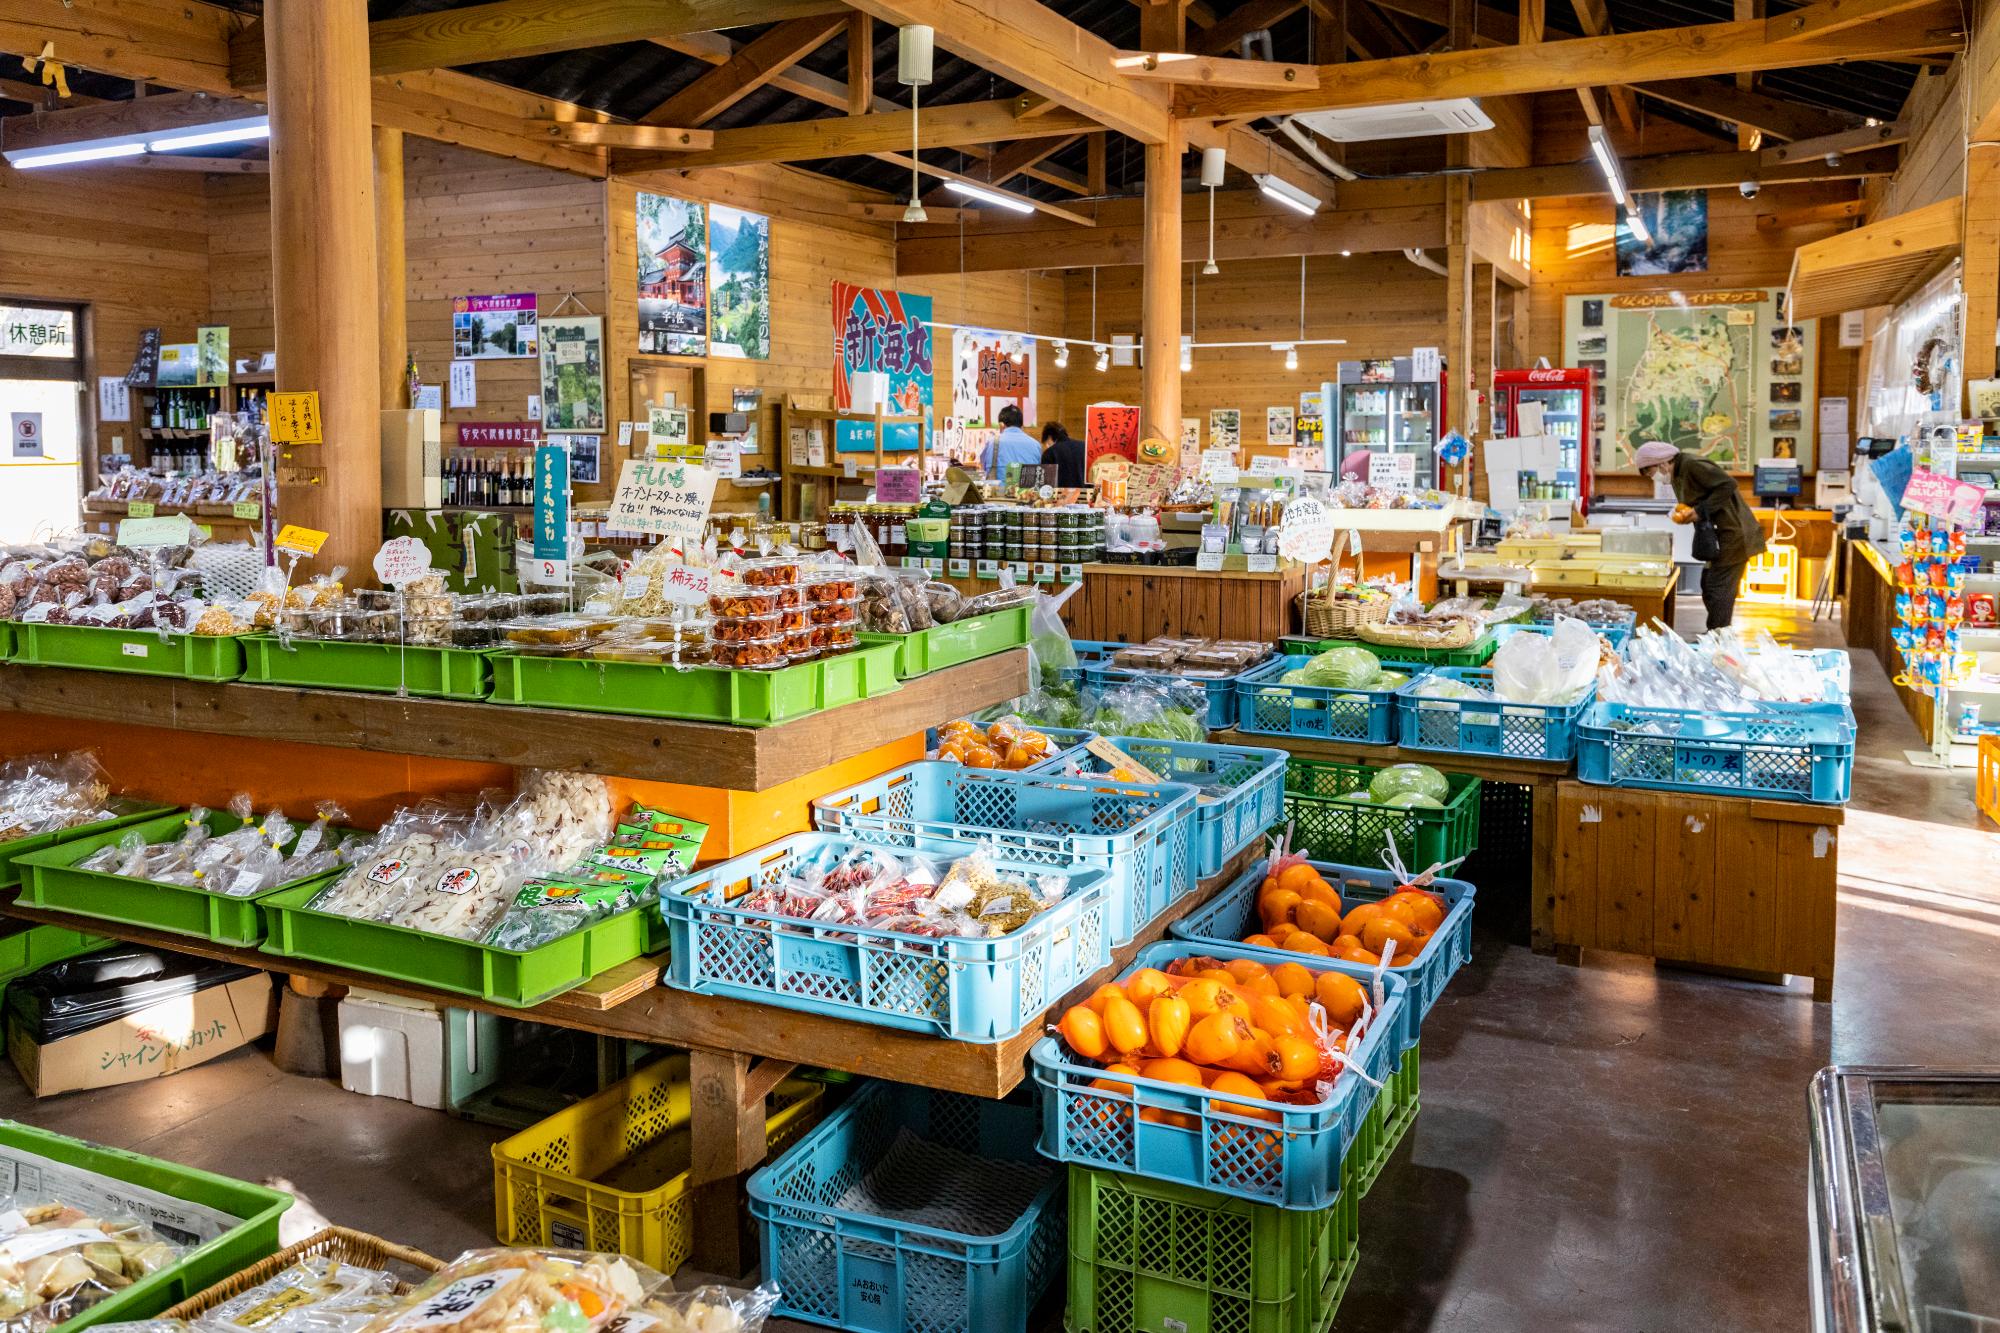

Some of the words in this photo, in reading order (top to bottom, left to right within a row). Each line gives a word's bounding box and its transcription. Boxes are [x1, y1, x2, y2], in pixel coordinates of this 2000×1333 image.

[9, 322, 66, 346] 休憩所
[846, 308, 933, 375] 新海丸
[981, 352, 1029, 391] 精肉コーナー
[632, 464, 686, 489] 干しいも
[1284, 502, 1321, 522] 地方発送
[670, 568, 709, 593] 柿チップス
[1295, 717, 1325, 732] 小の岩
[1679, 750, 1741, 770] 小の岩
[852, 1278, 889, 1295] JAおおいた
[860, 1291, 881, 1305] 安心院
